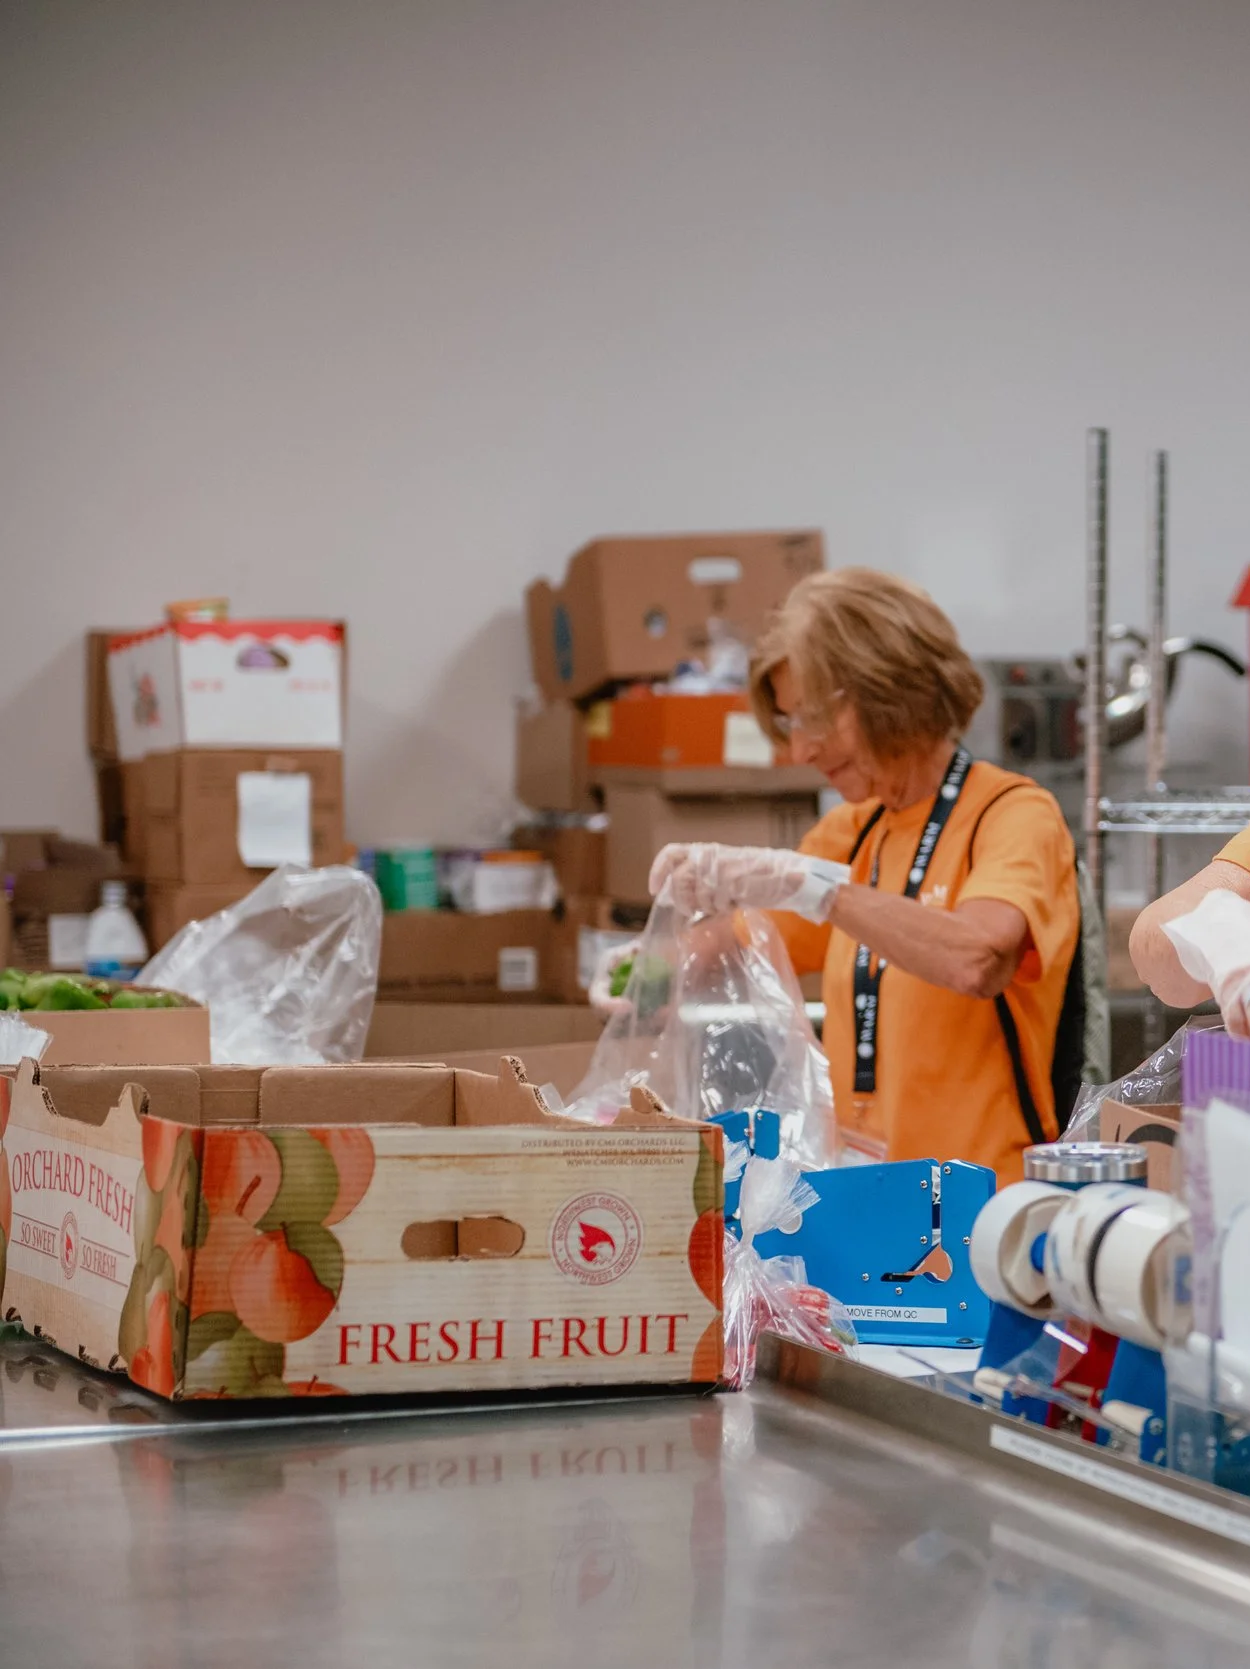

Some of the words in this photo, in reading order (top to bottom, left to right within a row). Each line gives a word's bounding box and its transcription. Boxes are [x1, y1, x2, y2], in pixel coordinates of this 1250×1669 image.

[521, 1139, 581, 1148] DISTRIBUTED
[585, 1139, 595, 1147] BY
[616, 1138, 667, 1147] ORCHARDS
[12, 1150, 85, 1197] ORCHARD
[87, 1162, 134, 1234] FRESH
[598, 1196, 632, 1221] GROWN
[21, 1222, 31, 1244] SO
[32, 1226, 56, 1253] SWEET
[82, 1244, 92, 1268] SO
[92, 1249, 117, 1278] FRESH
[875, 1309, 902, 1318] FROM
[903, 1310, 918, 1319] QC
[336, 1319, 506, 1365] FRESH
[529, 1314, 689, 1359] FRUIT
